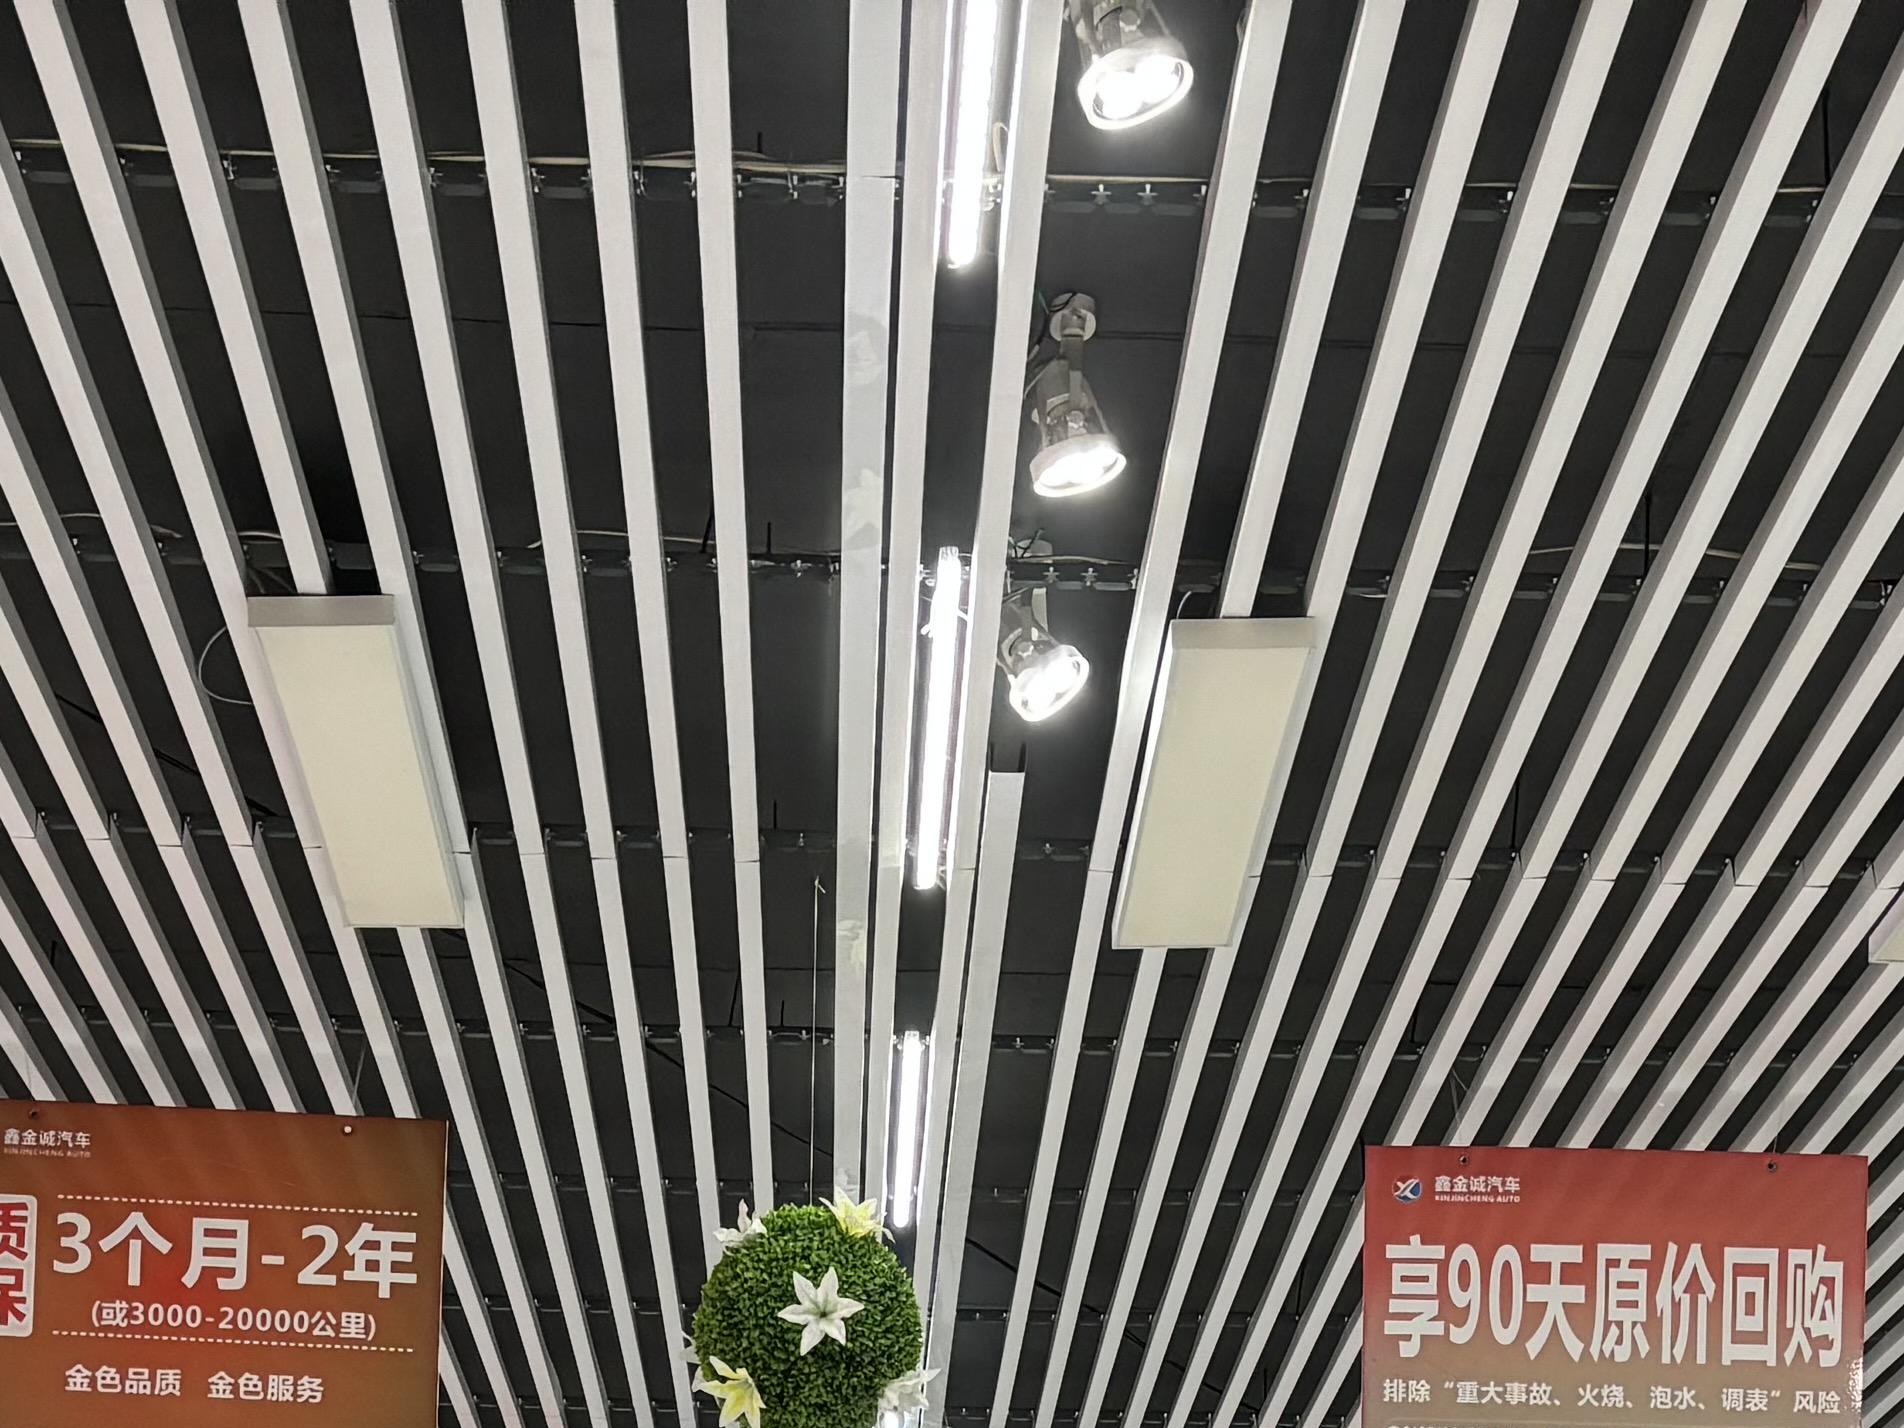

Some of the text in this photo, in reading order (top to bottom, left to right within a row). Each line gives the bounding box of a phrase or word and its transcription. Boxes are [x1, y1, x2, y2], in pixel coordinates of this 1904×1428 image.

[3, 1128, 91, 1148] 鑫金诚汽车
[1434, 1175, 1521, 1193] 鑫金诚汽车
[52, 1210, 418, 1299] 3个月-2年
[1383, 1234, 1844, 1368] 享90天原价回购
[64, 1364, 325, 1404] 金色品质 金色服务
